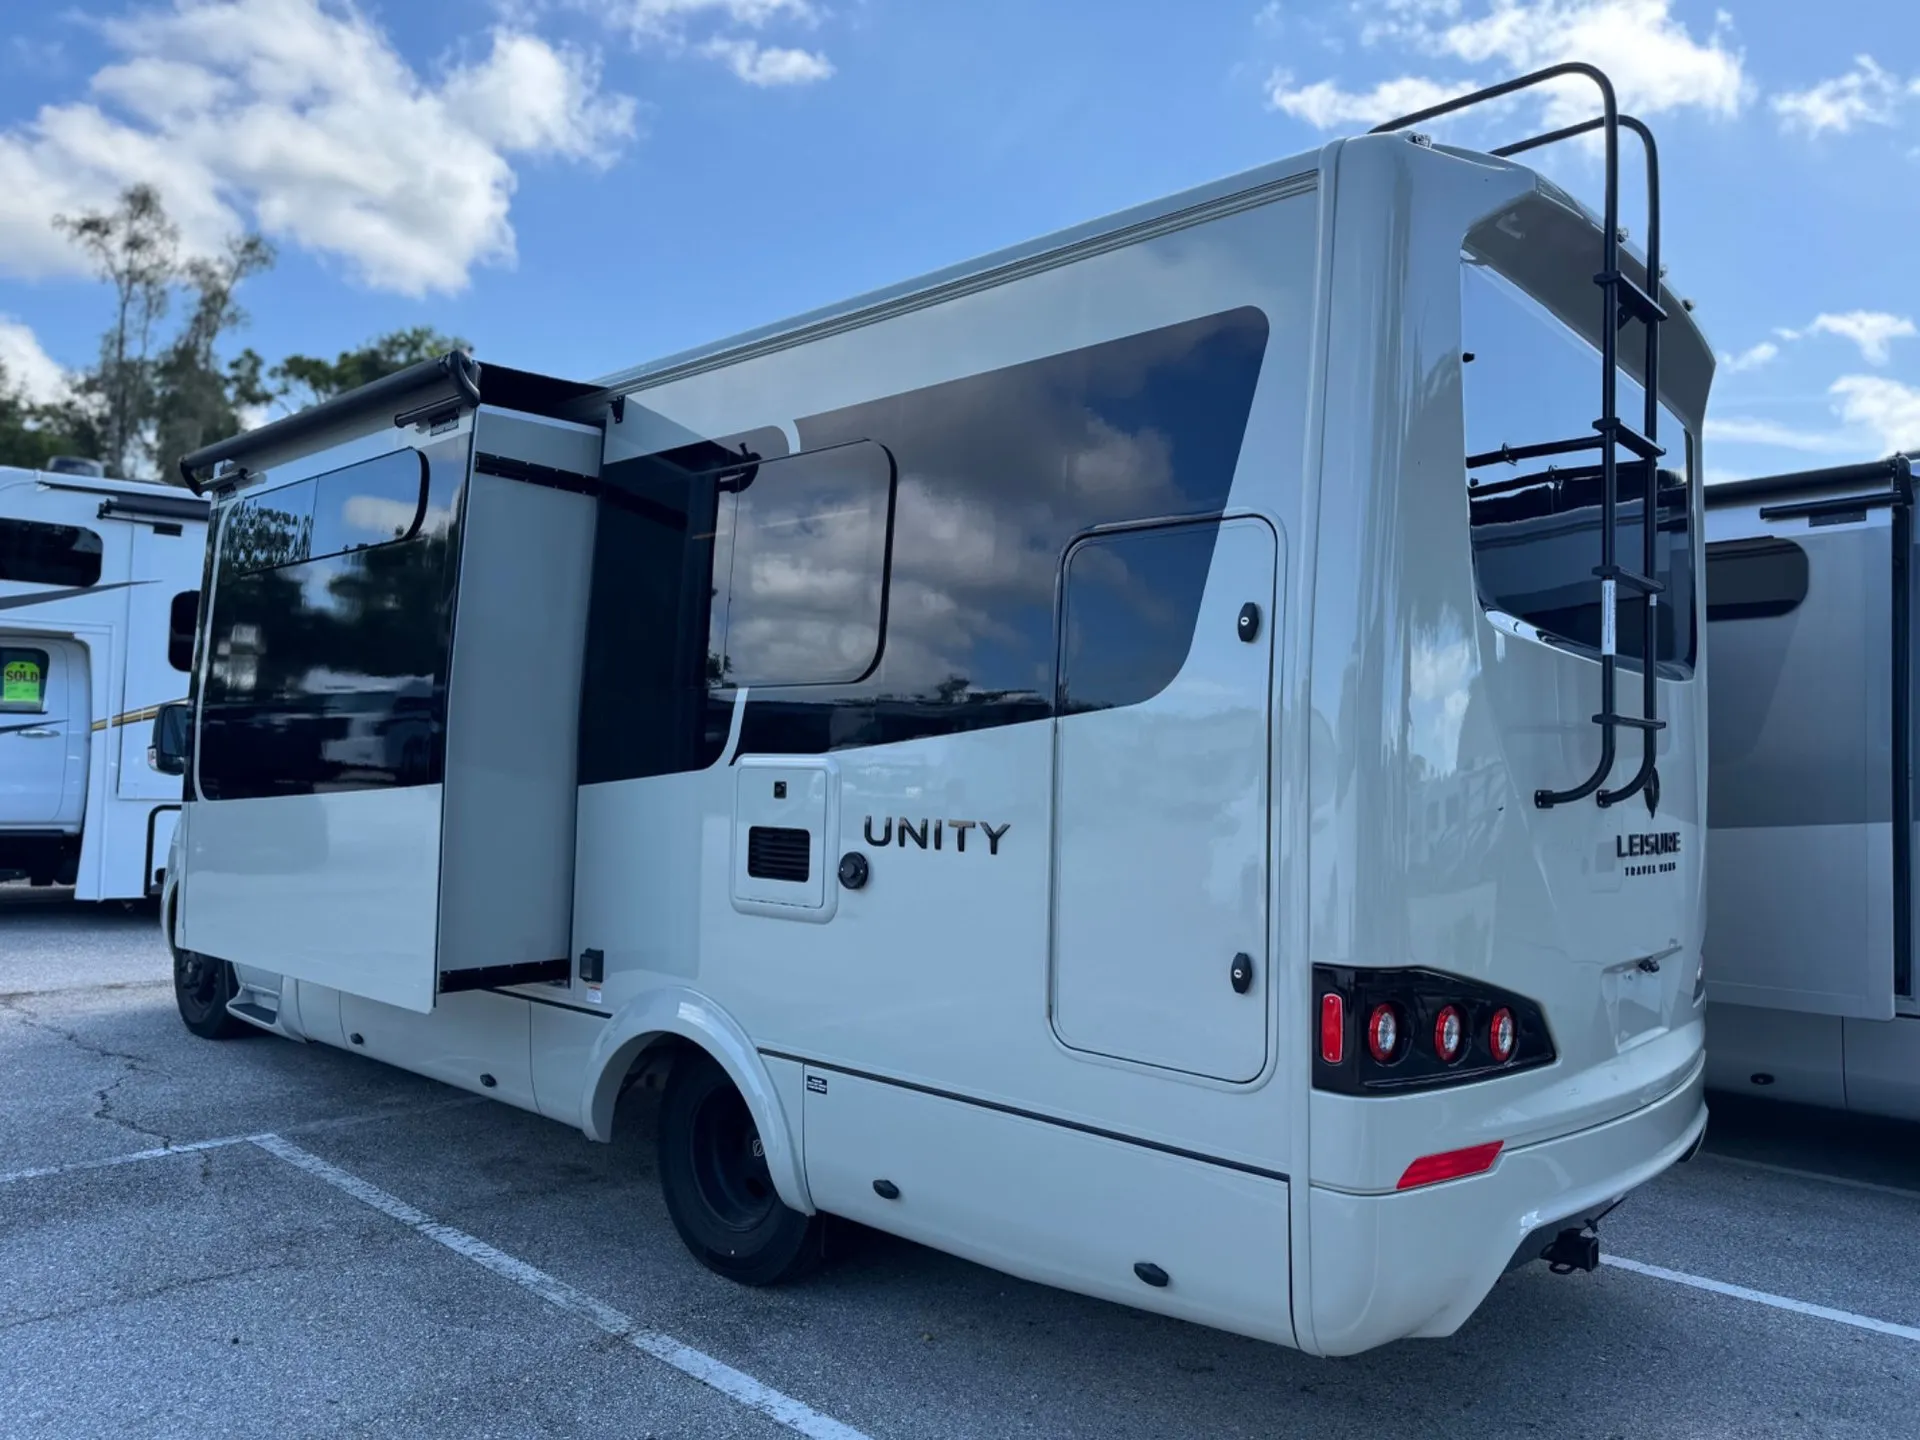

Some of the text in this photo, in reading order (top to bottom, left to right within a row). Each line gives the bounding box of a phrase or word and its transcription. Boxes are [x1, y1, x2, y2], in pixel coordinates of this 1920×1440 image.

[5, 670, 39, 683] SOLD
[864, 815, 1011, 855] UNITY
[1616, 832, 1681, 858] LEISURE
[1624, 864, 1656, 876] TRAVEL
